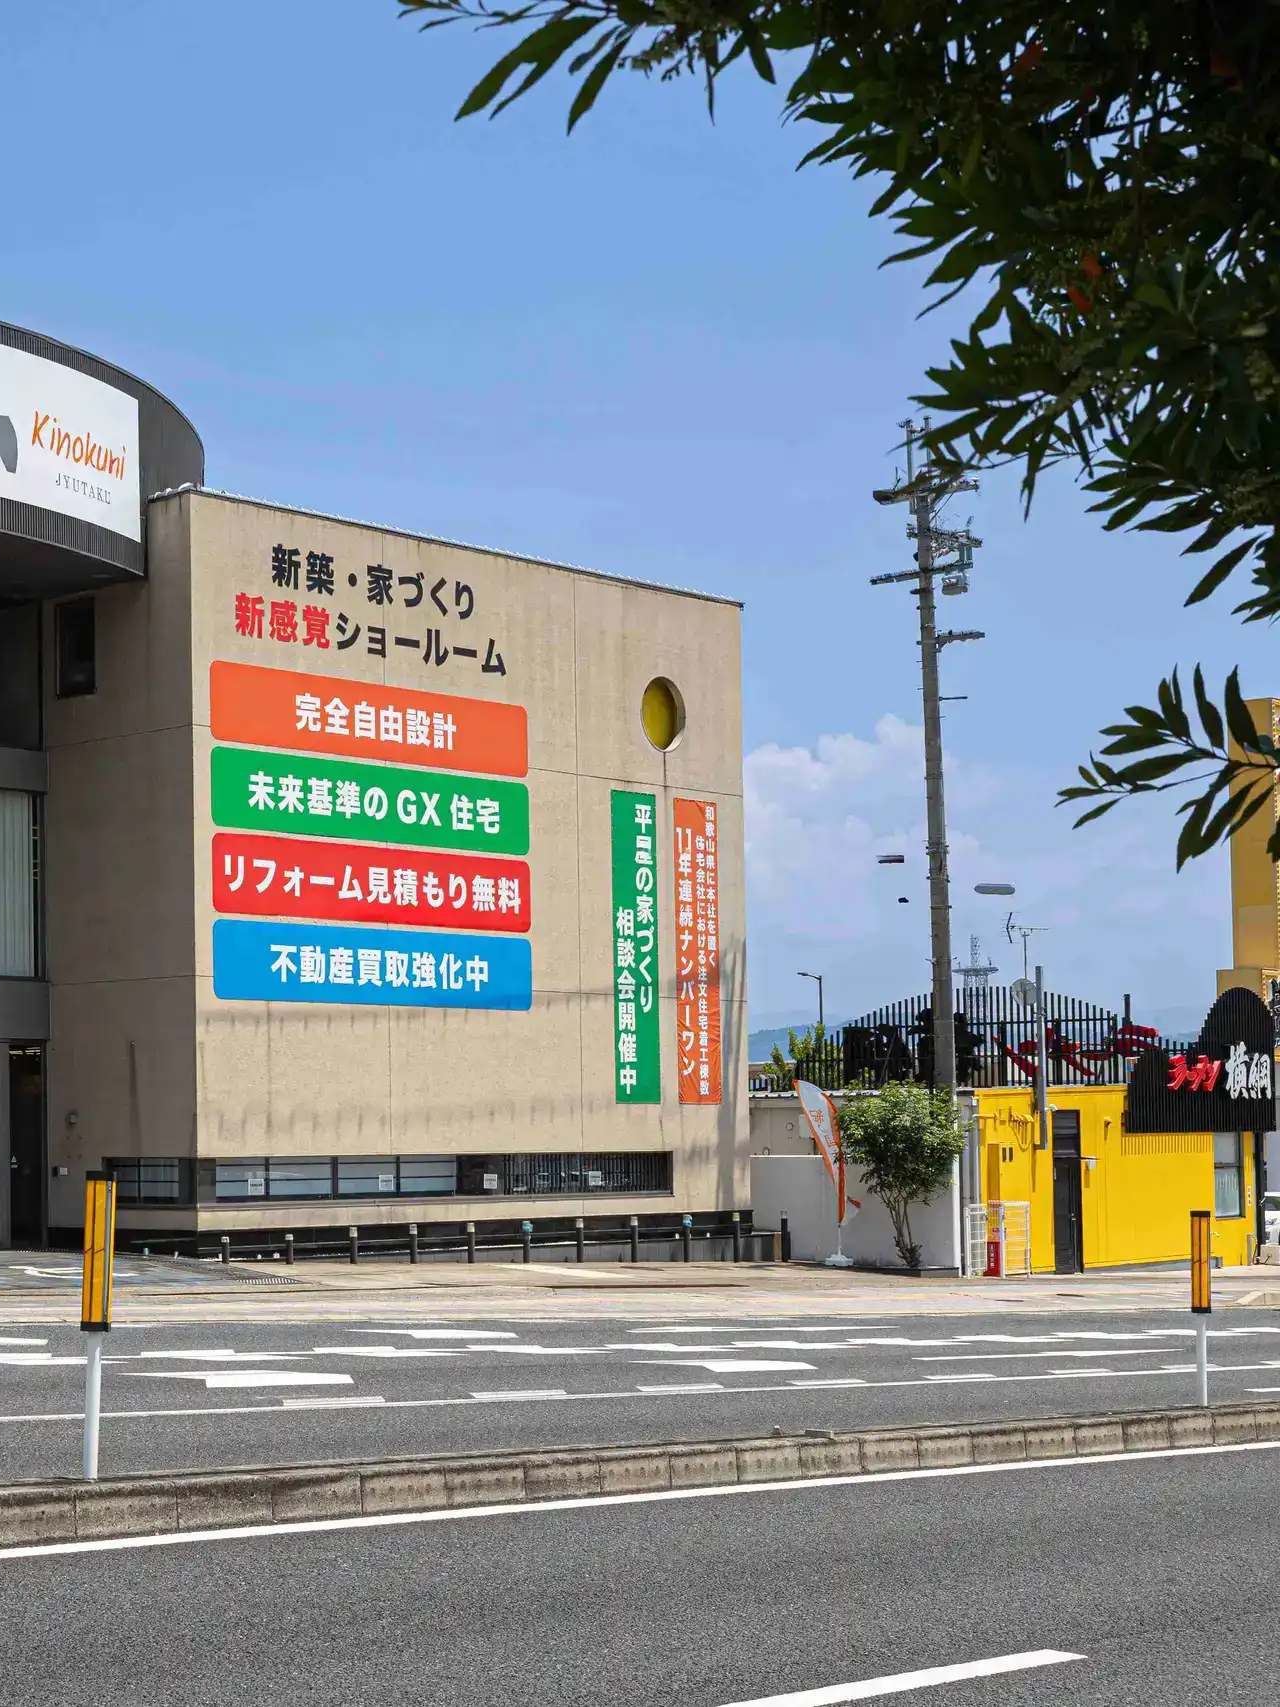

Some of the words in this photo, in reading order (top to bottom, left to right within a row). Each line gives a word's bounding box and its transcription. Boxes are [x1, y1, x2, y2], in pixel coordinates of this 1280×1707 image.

[31, 410, 127, 481] Kinokuni
[55, 473, 112, 505] JYUTAKU
[271, 543, 474, 620] 新築・家づくり
[235, 592, 507, 677] 新感覚ショールーム
[295, 693, 457, 750] 完全自由設計
[224, 854, 522, 915] リフォーム見積もり無料
[704, 805, 717, 967] 和歌山県に本社を置く
[270, 944, 489, 991] 不動産買取強化中
[616, 906, 638, 1095] 相談会開催中
